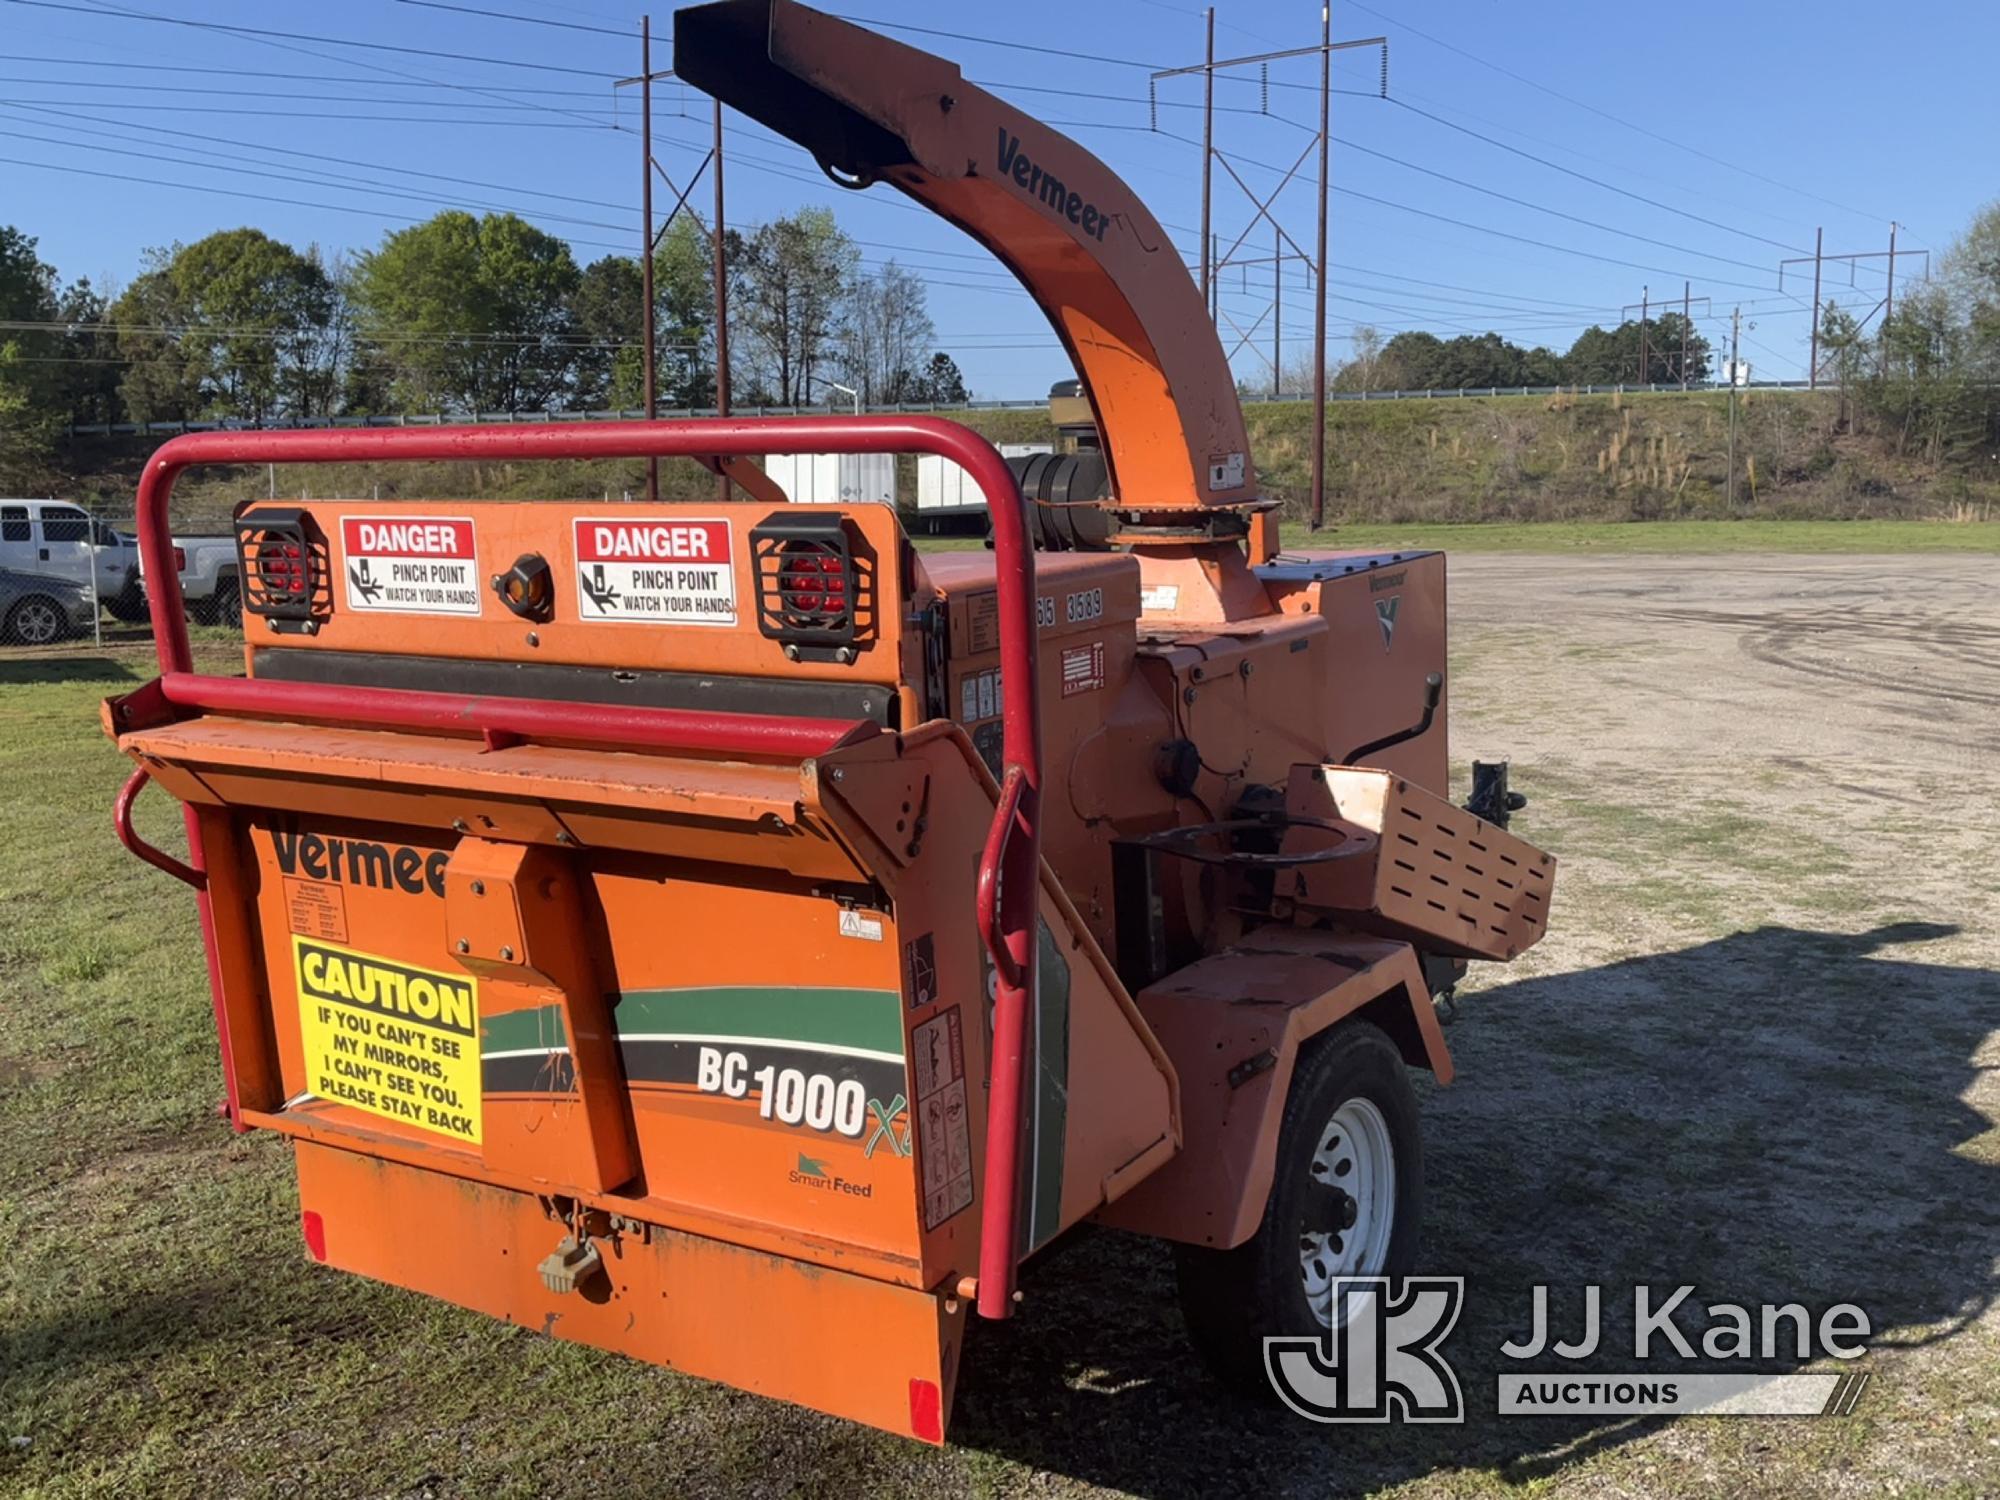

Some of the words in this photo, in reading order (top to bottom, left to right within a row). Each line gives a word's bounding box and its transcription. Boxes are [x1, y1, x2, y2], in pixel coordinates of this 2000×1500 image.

[998, 127, 1110, 242] Vermeer
[359, 523, 458, 553] DANGER
[594, 527, 710, 558] DANGER
[385, 587, 417, 603] WATCH
[419, 588, 444, 604] YOUR
[445, 589, 477, 606] HANDS
[392, 563, 428, 583] PINCH
[430, 564, 466, 584] POINT
[632, 569, 673, 590] PINCH
[677, 571, 719, 591] POINT
[623, 594, 660, 612] WATCH
[663, 597, 693, 613] YOUR
[695, 597, 732, 614] HANDS
[1068, 589, 1101, 621] 3589
[266, 818, 450, 899] Vermee
[302, 952, 473, 1030] CAUTION
[317, 1005, 333, 1025] IF
[335, 1010, 372, 1036] YOU
[375, 1021, 427, 1051] CAN'T
[430, 1036, 462, 1060] SEE
[324, 1054, 331, 1072] I
[333, 1058, 383, 1087] CAN'T
[386, 1072, 416, 1096] SEE
[418, 1081, 465, 1110] YOU.
[333, 1033, 360, 1057] MY
[363, 1042, 450, 1085] MIRRORS,
[697, 1046, 749, 1099] BC
[319, 1076, 378, 1108] PLEASE
[380, 1095, 424, 1121] STAY
[426, 1107, 476, 1137] BACK
